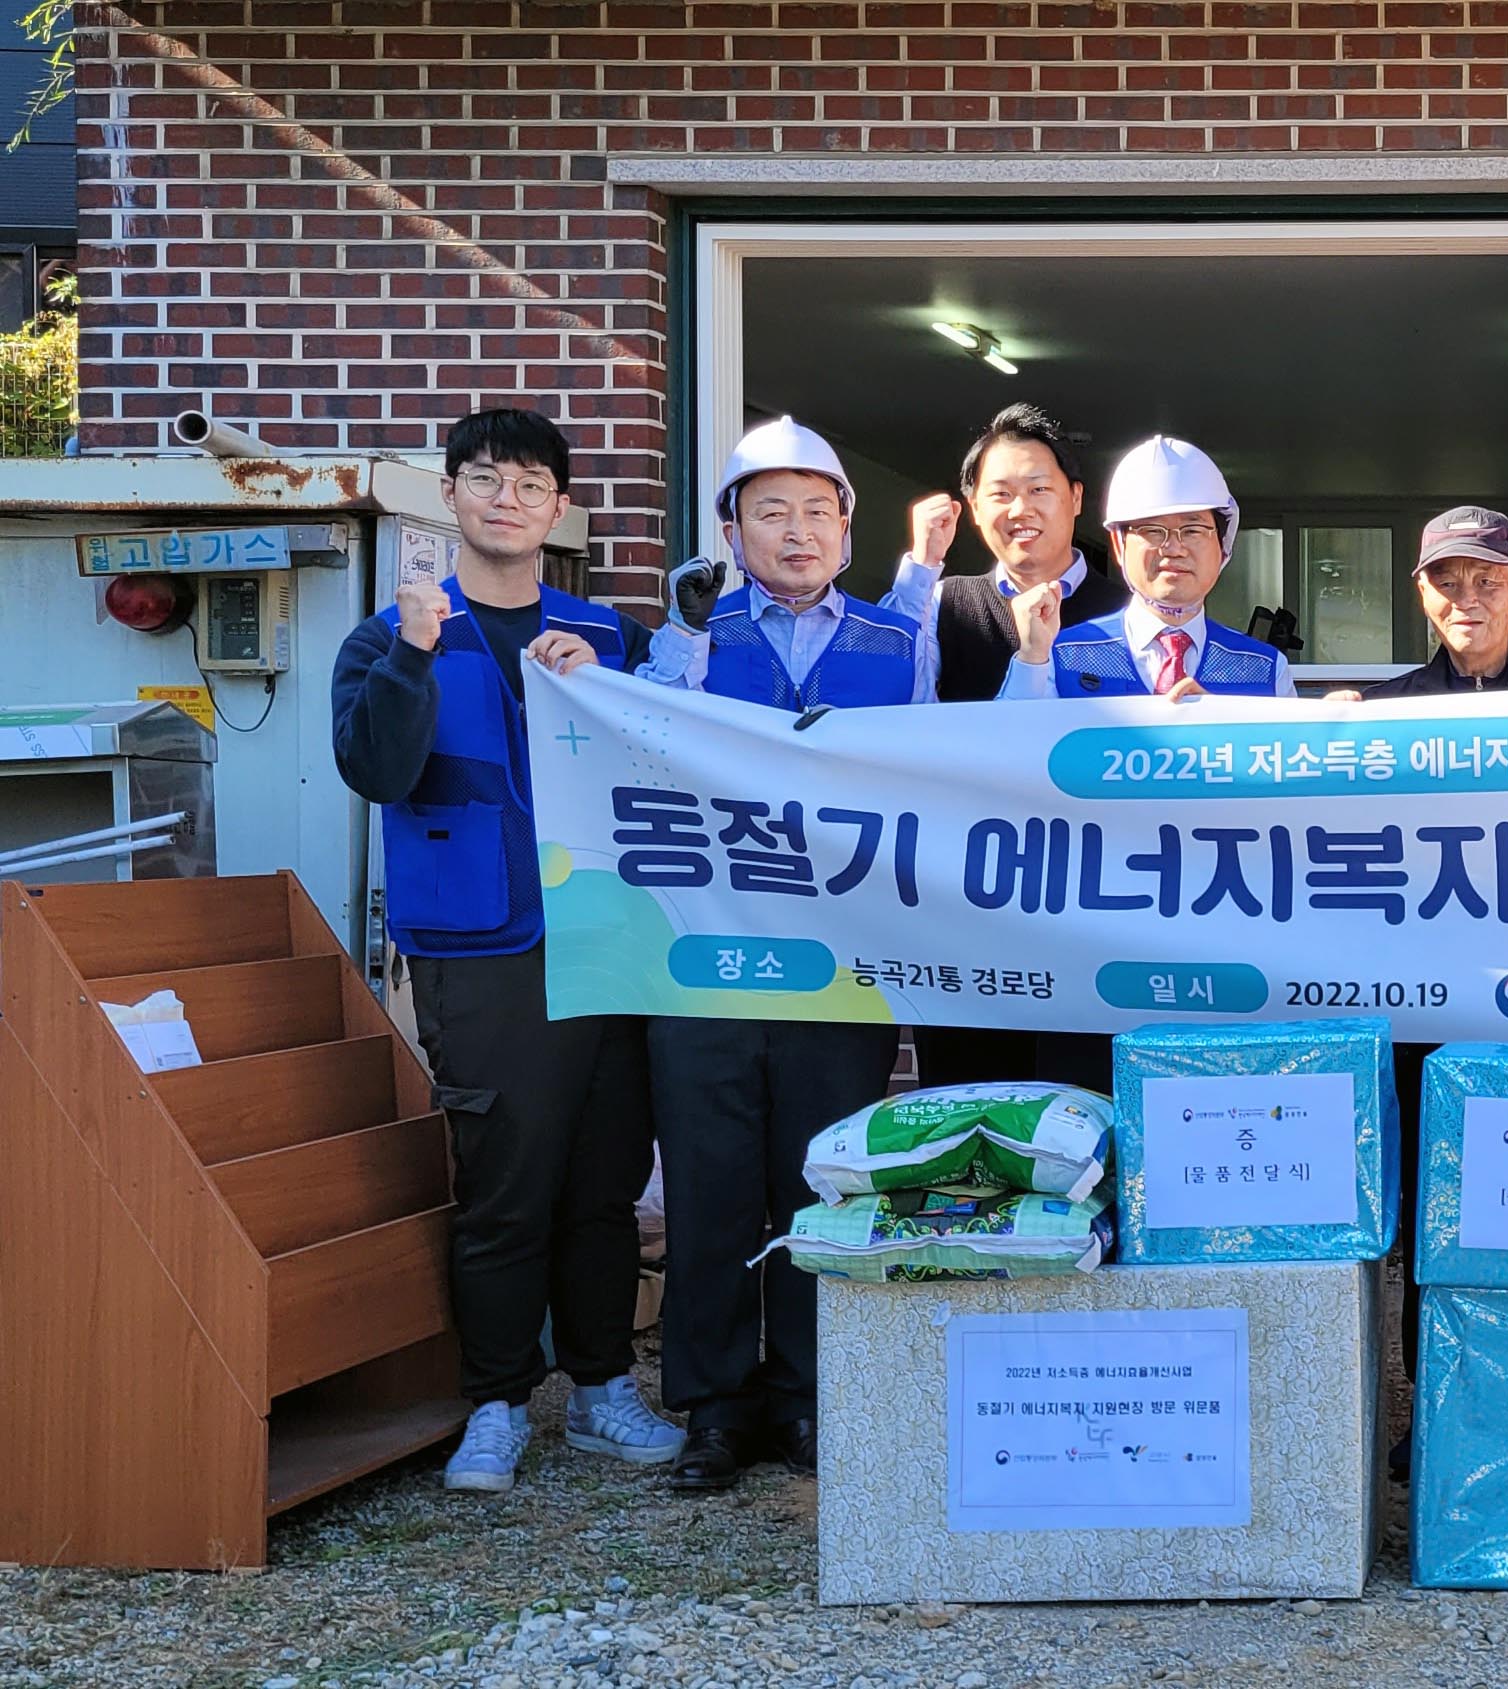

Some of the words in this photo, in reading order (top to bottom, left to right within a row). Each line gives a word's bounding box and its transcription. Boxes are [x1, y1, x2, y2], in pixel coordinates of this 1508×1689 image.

[118, 532, 278, 567] 고압가스
[1102, 741, 1234, 784] 2022년
[1248, 739, 1398, 784] 저소득층
[611, 786, 921, 908] 동절기
[852, 956, 964, 994] 능곡21통
[971, 966, 1056, 1000] 경로당
[1285, 981, 1449, 1008] 2022.10.19
[1235, 1128, 1258, 1152] 증
[1005, 1366, 1042, 1379] 2022년
[1047, 1366, 1090, 1379] 저소득층
[1095, 1365, 1193, 1379] 에너지효율개선사업
[976, 1401, 1015, 1416] 동절기
[1021, 1401, 1085, 1417] 에너지복지
[1092, 1401, 1144, 1416] 지원현장
[1151, 1400, 1177, 1416] 방문
[1184, 1400, 1221, 1415] 위문품
